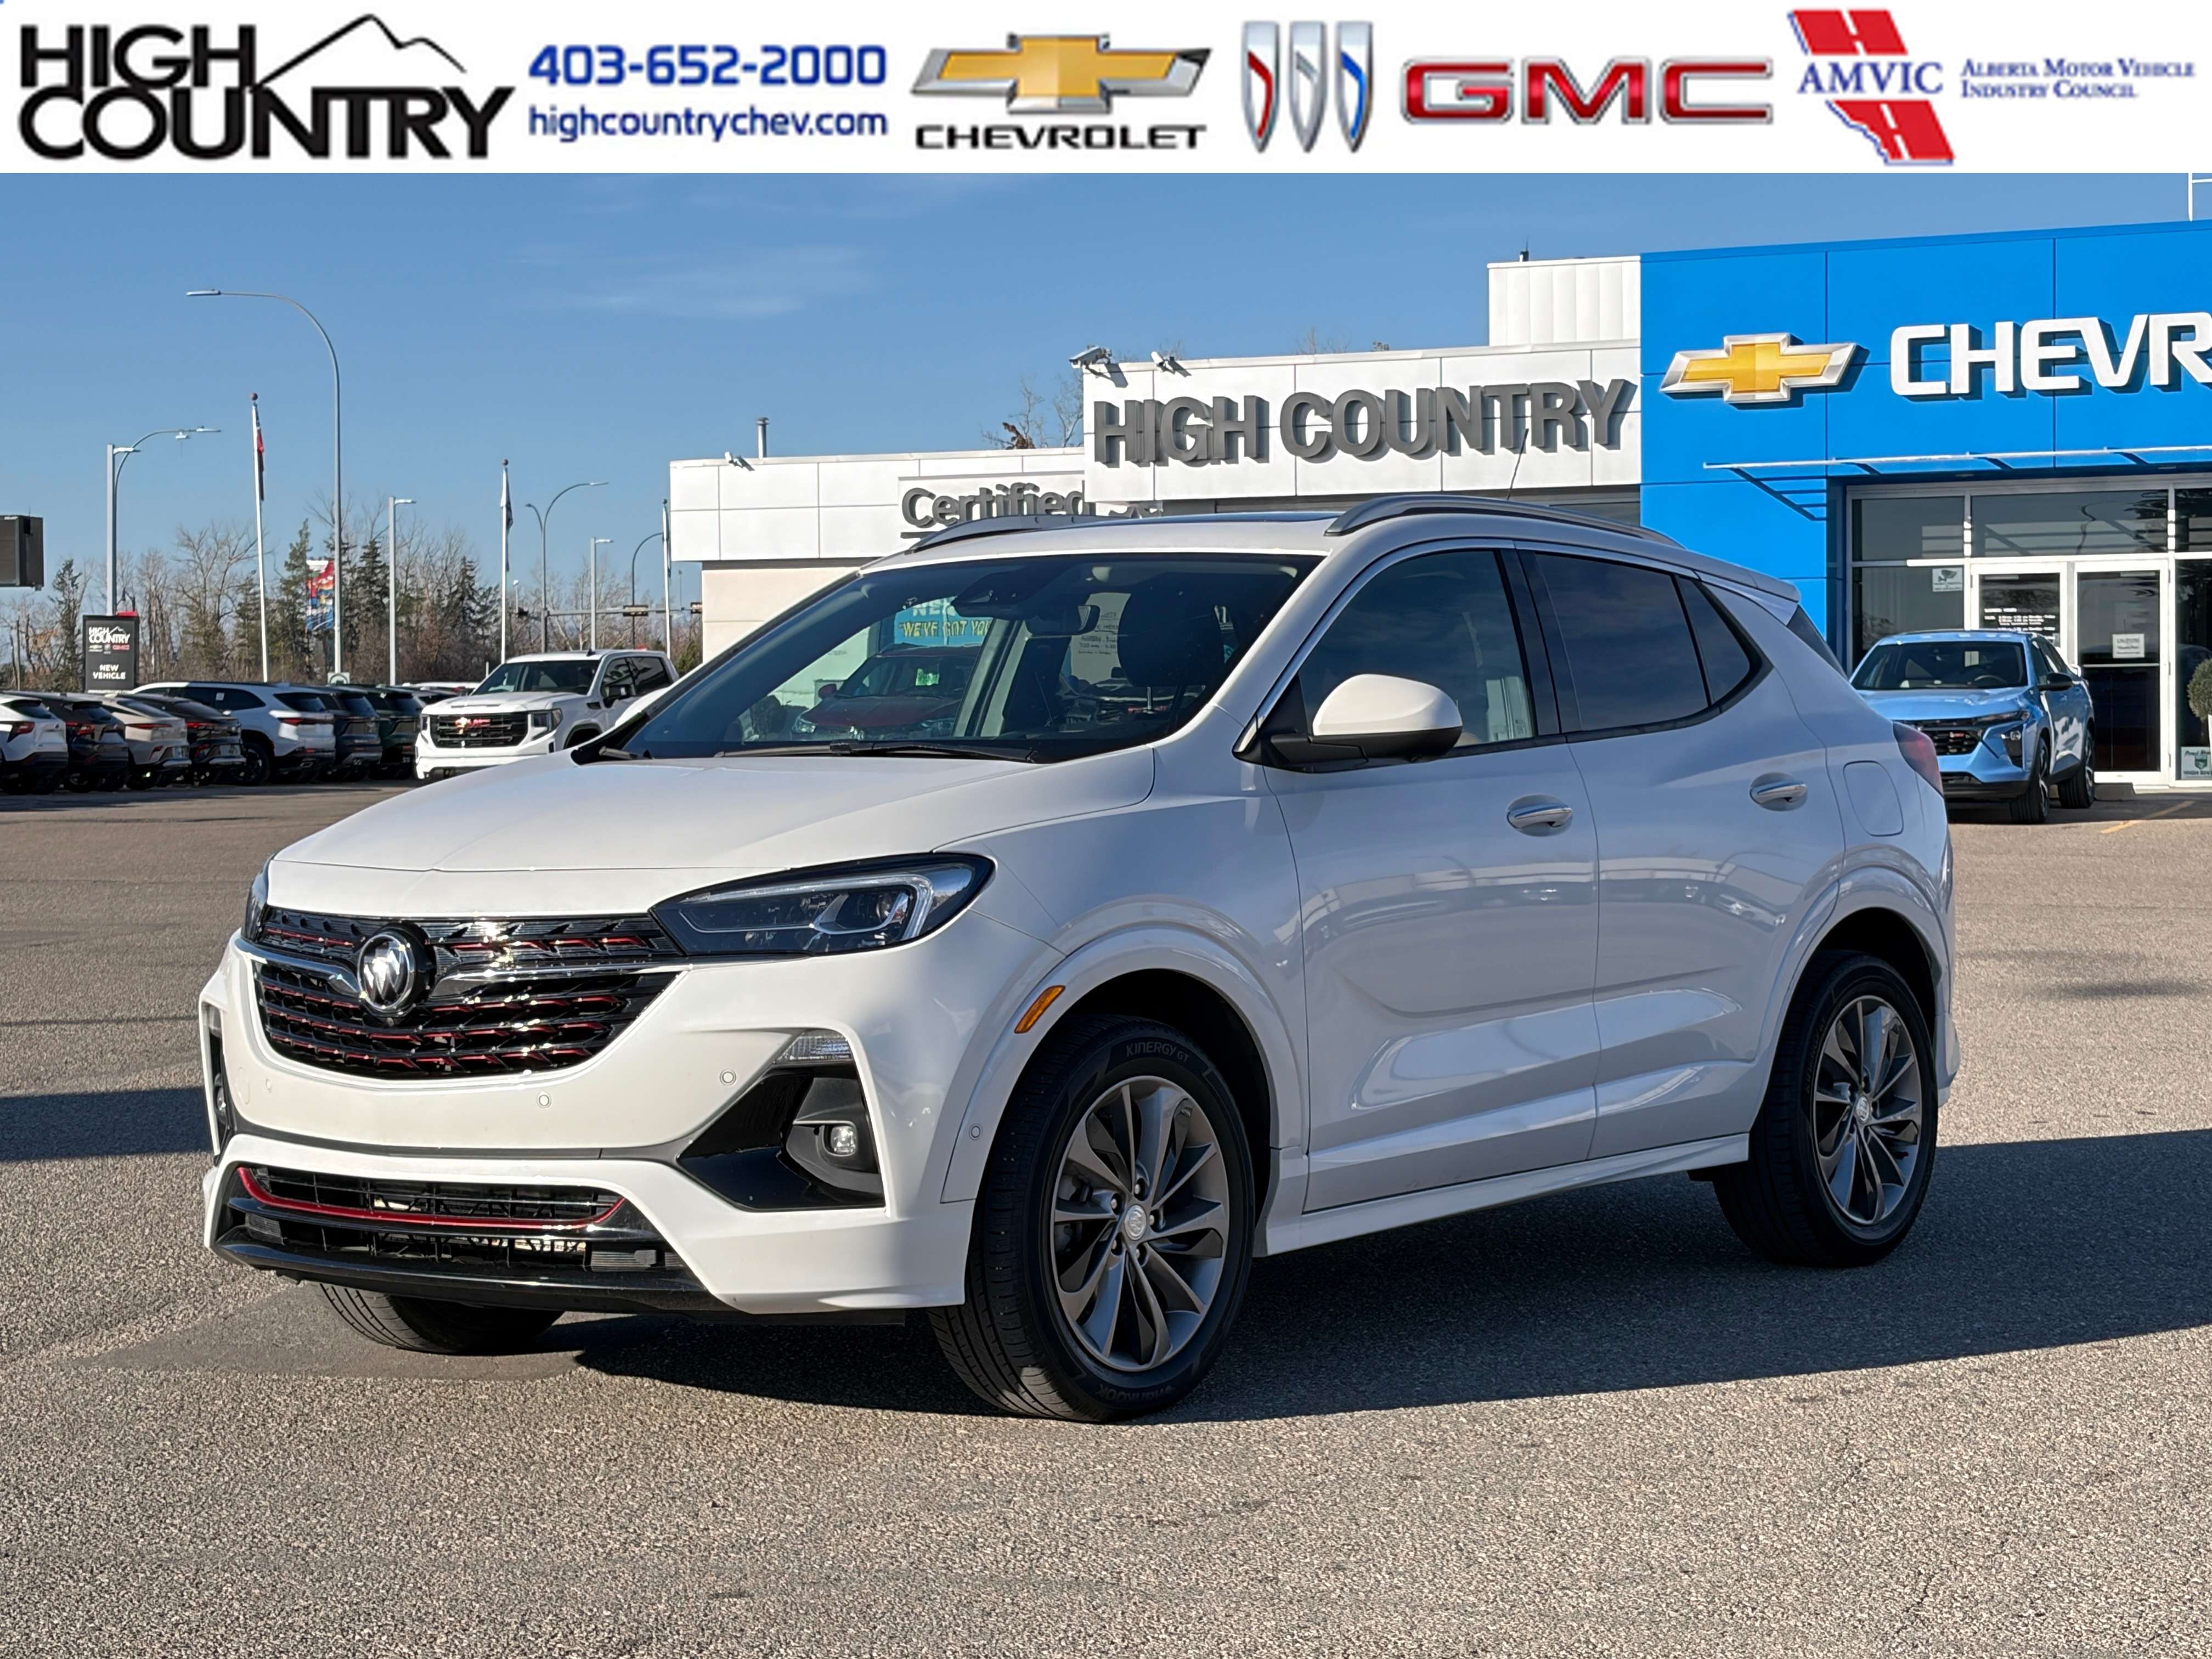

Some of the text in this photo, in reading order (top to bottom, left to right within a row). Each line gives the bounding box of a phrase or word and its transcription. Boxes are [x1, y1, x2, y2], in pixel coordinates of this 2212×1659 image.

[1891, 312, 2212, 396] CHEVR
[1094, 379, 1635, 466] HIGH COUNTRY
[902, 482, 1096, 528] Certified
[89, 627, 110, 635] HIGH
[89, 633, 131, 644] COUNTRY
[92, 672, 126, 680] VEHICLE
[1177, 1050, 1190, 1063] GT
